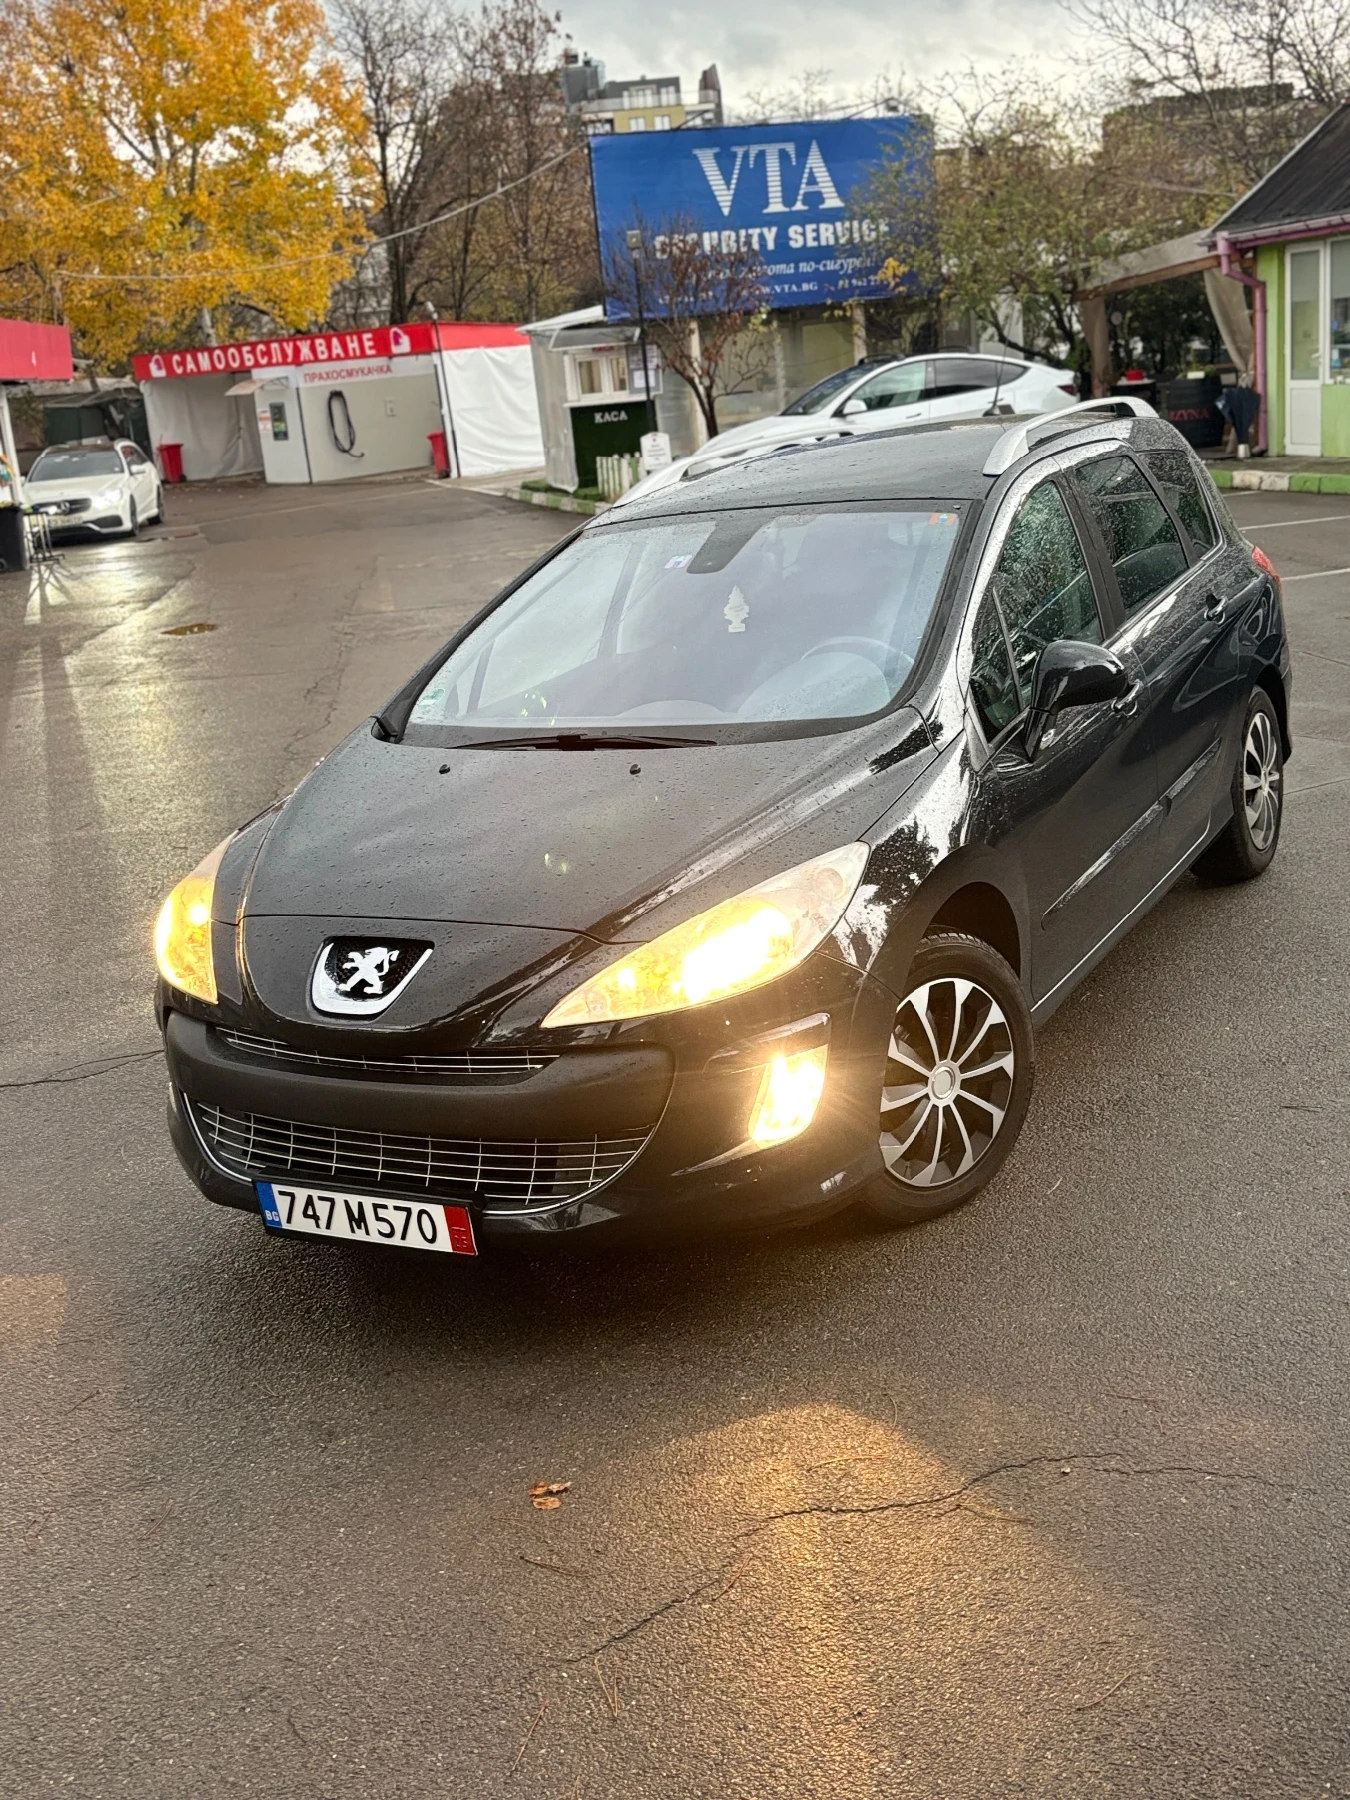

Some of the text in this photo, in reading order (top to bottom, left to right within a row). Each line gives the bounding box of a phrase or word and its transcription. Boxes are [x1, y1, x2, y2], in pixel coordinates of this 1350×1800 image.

[692, 139, 846, 217] VTA
[172, 332, 376, 375] САМООБСЛУЖВАНЕ
[303, 363, 393, 384] ПРАХОСМУКАЧКА
[593, 410, 628, 424] КАСА
[264, 1209, 280, 1222] BG
